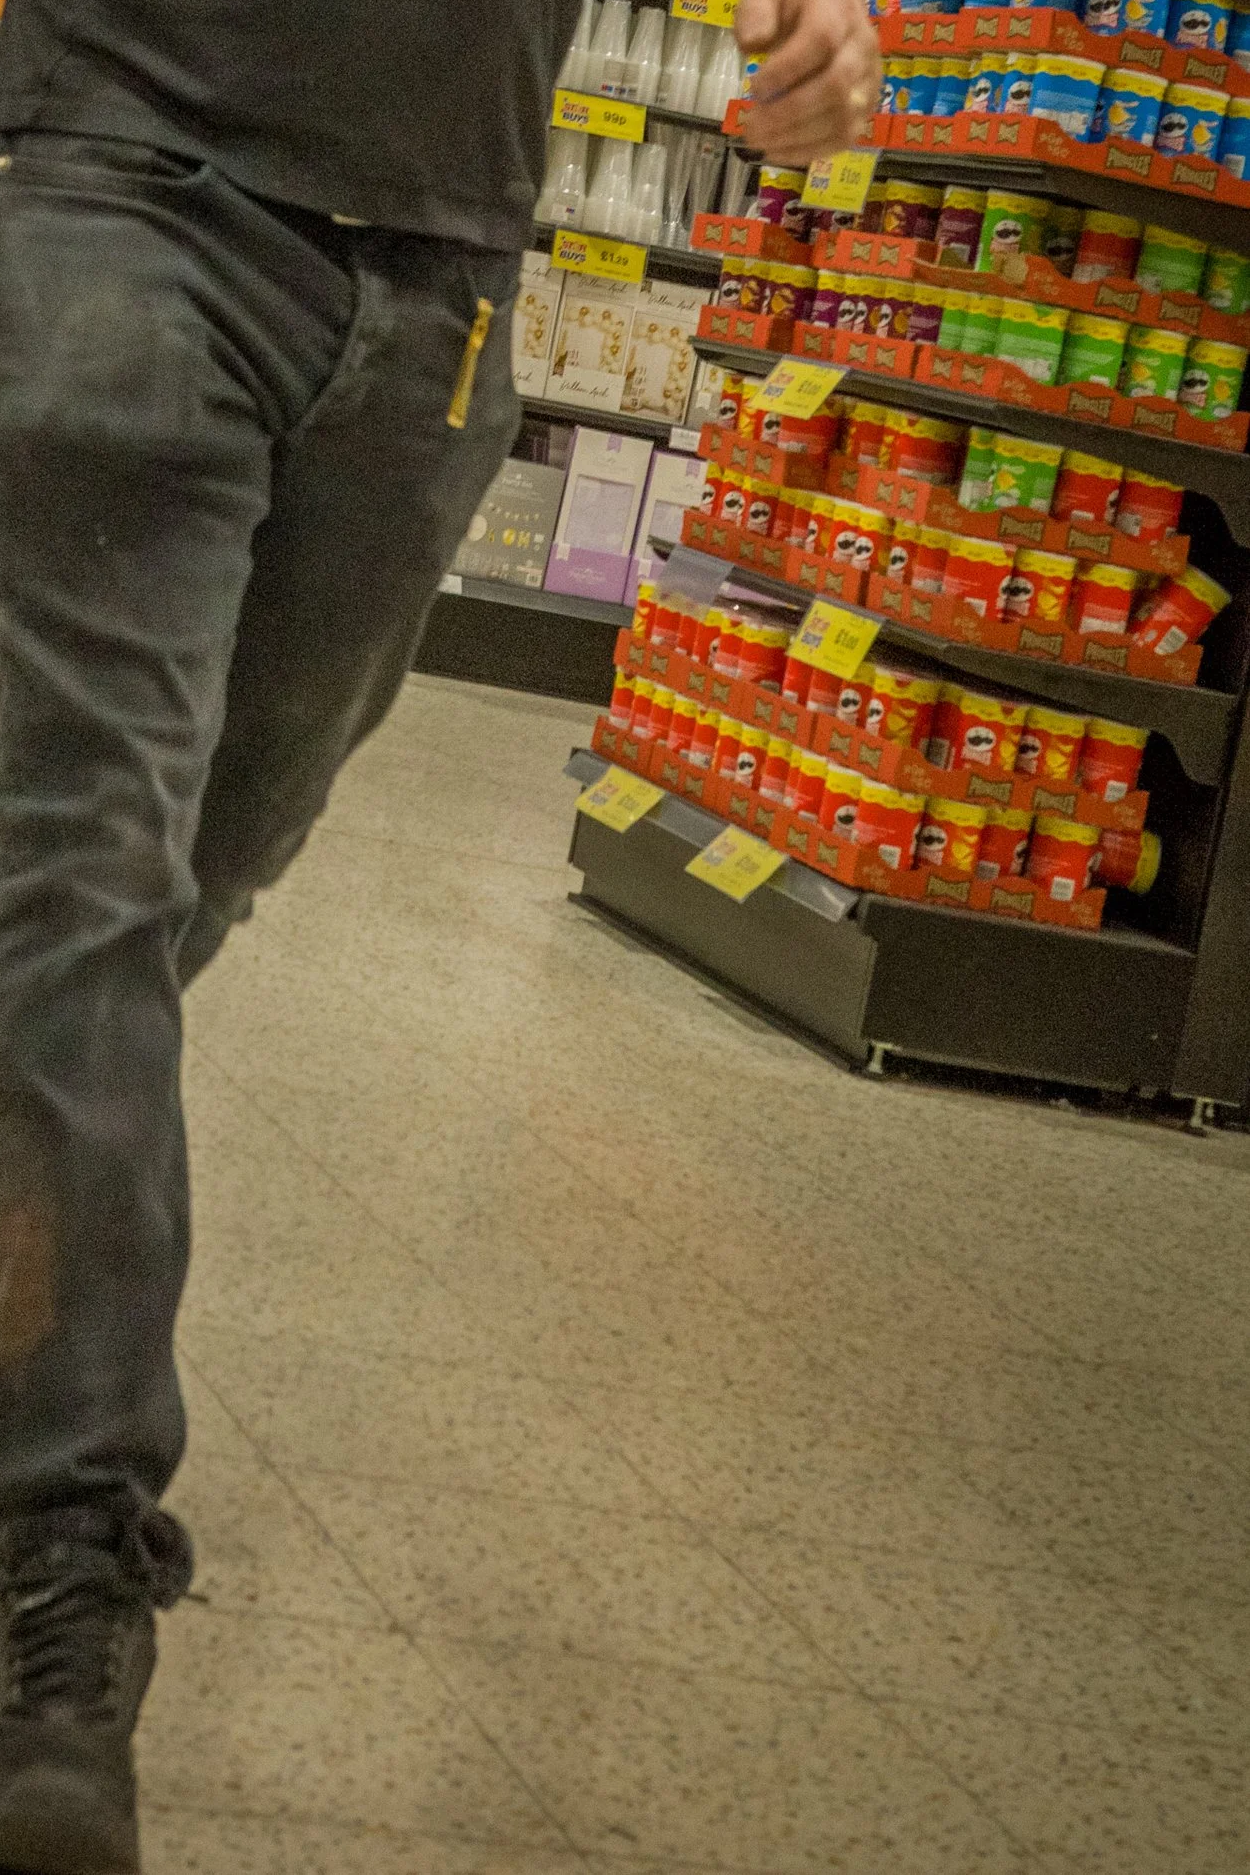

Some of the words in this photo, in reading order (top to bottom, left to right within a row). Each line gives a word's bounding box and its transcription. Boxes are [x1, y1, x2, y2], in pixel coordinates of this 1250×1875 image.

[562, 111, 590, 125] BUYS
[603, 110, 627, 126] 99p
[559, 249, 587, 263] BUYS
[600, 250, 629, 267] £1.29
